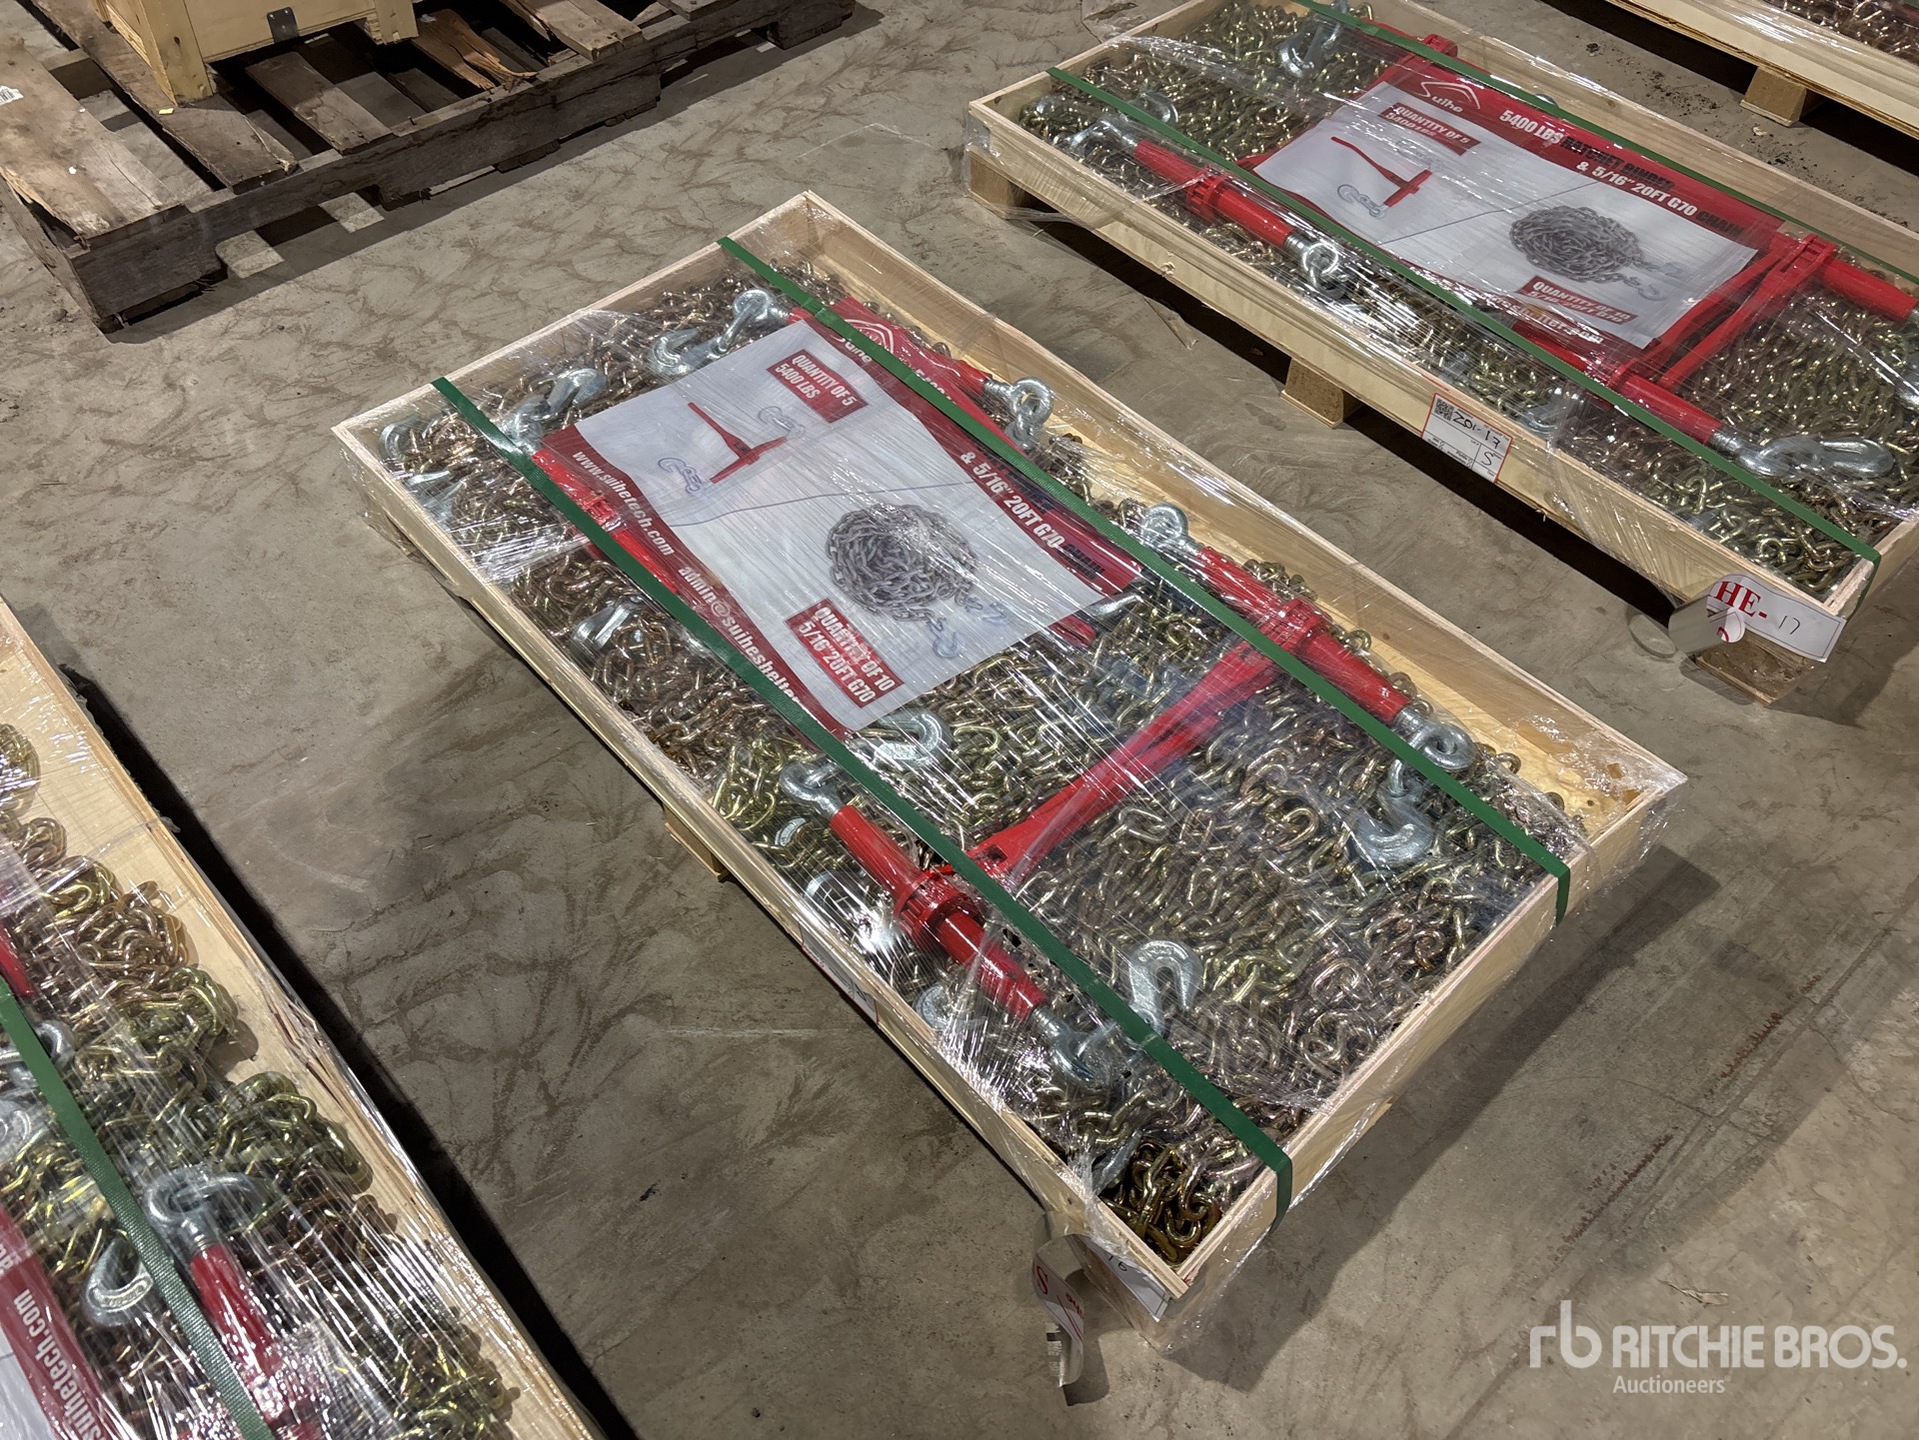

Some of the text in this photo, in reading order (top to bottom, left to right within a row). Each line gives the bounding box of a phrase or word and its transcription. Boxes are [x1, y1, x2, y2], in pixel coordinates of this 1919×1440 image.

[1394, 106, 1445, 135] QUANTITY
[1499, 108, 1539, 133] 5400
[1534, 125, 1565, 145] LBS
[1576, 161, 1590, 172] &
[1591, 165, 1635, 187] 5/16"
[1630, 182, 1671, 203] 20FT
[1666, 197, 1698, 217] G70
[1532, 281, 1593, 309] QUANTITY
[774, 363, 821, 400] 5400 LBS
[791, 354, 858, 407] QUANTITY OF 5
[572, 451, 675, 556] www.suihetech.com
[960, 451, 976, 464] &
[973, 462, 1015, 494] 5/16"
[1003, 494, 1044, 527] 20FT
[1033, 520, 1066, 549] G70
[811, 606, 896, 692] QUANTITY OF 10
[847, 678, 877, 703] G70
[13, 1288, 107, 1440] suihetech.com
